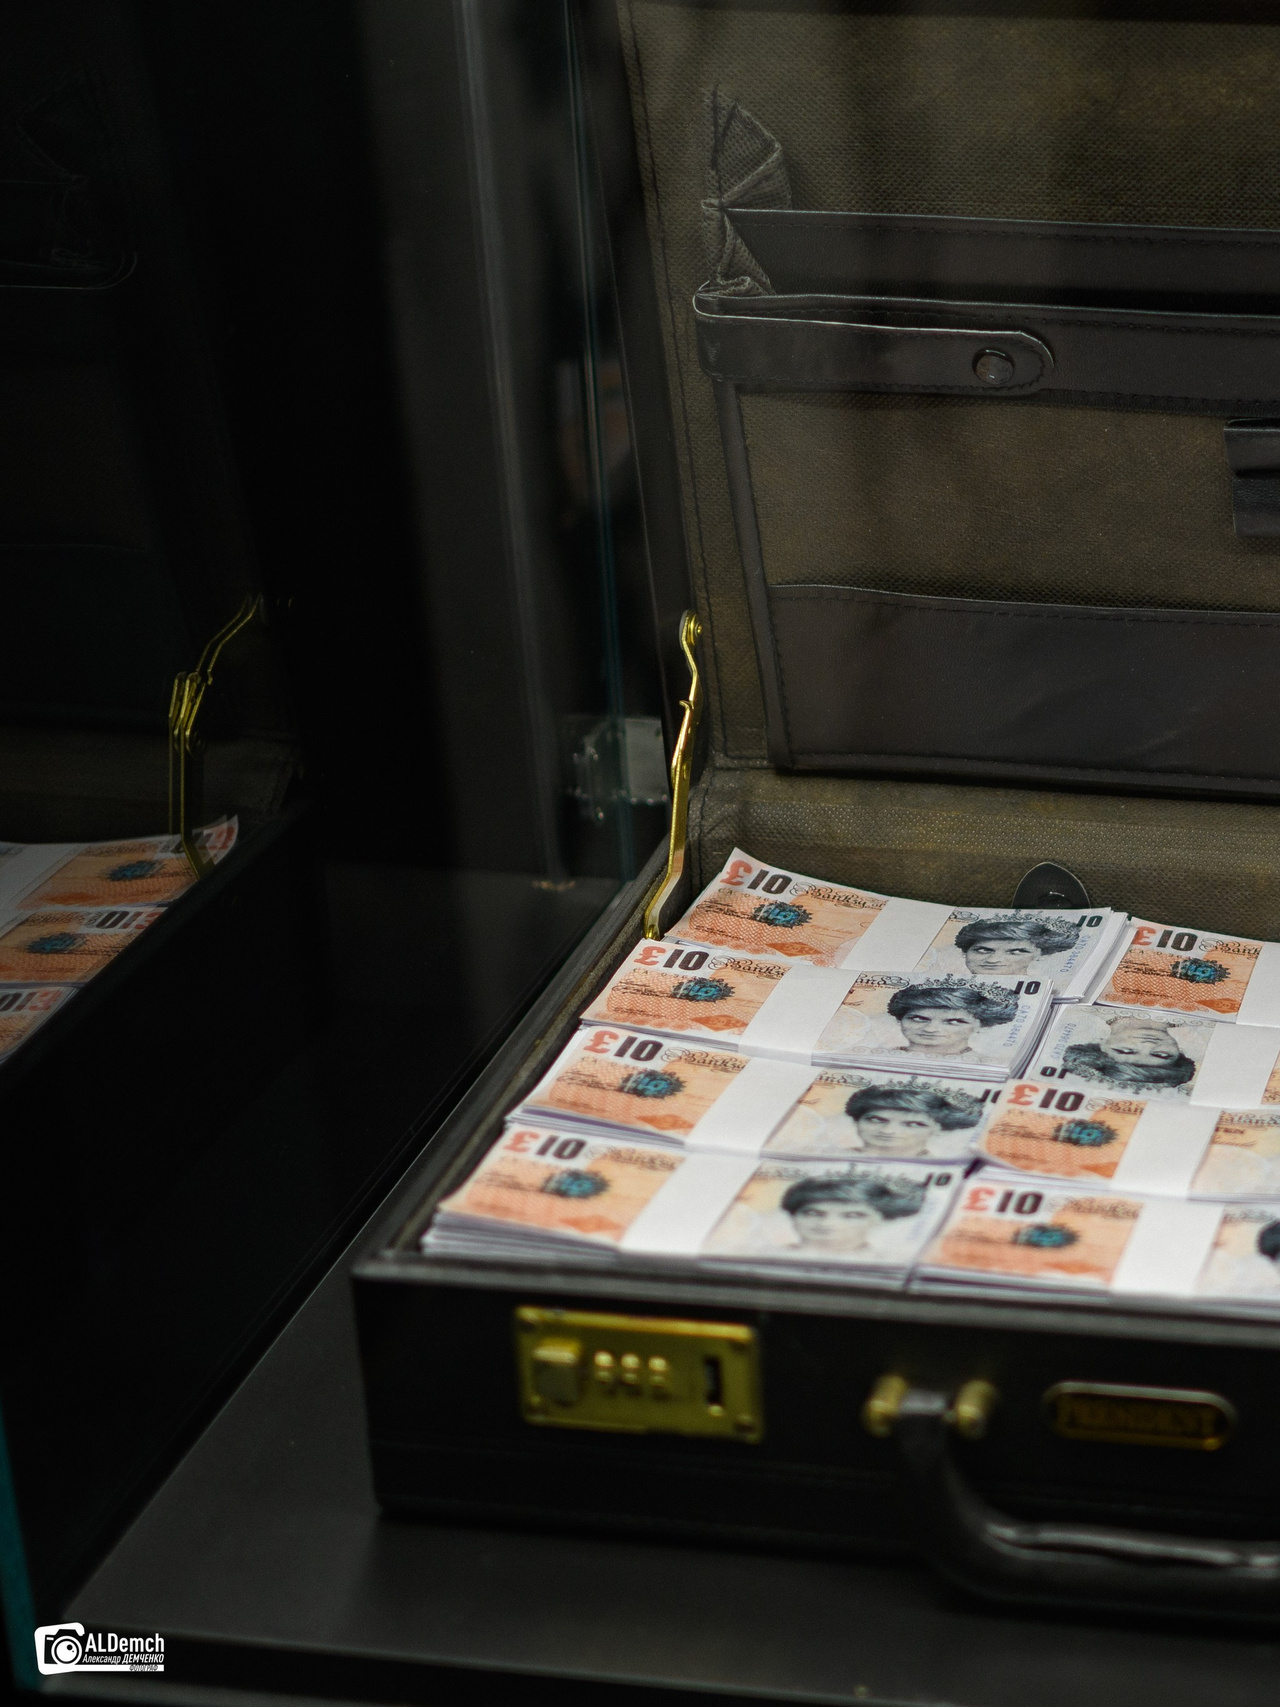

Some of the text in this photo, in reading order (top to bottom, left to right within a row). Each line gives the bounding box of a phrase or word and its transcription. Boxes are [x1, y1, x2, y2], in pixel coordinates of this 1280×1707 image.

[720, 860, 793, 894] £10
[1076, 915, 1103, 928] 10
[1131, 926, 1198, 952] £10
[634, 946, 709, 971] £10
[1013, 980, 1041, 995] 10
[583, 1030, 664, 1061] £10
[1008, 1084, 1085, 1111] £10
[503, 1131, 587, 1160] £10
[923, 1172, 952, 1187] 10
[963, 1187, 1044, 1214] £10
